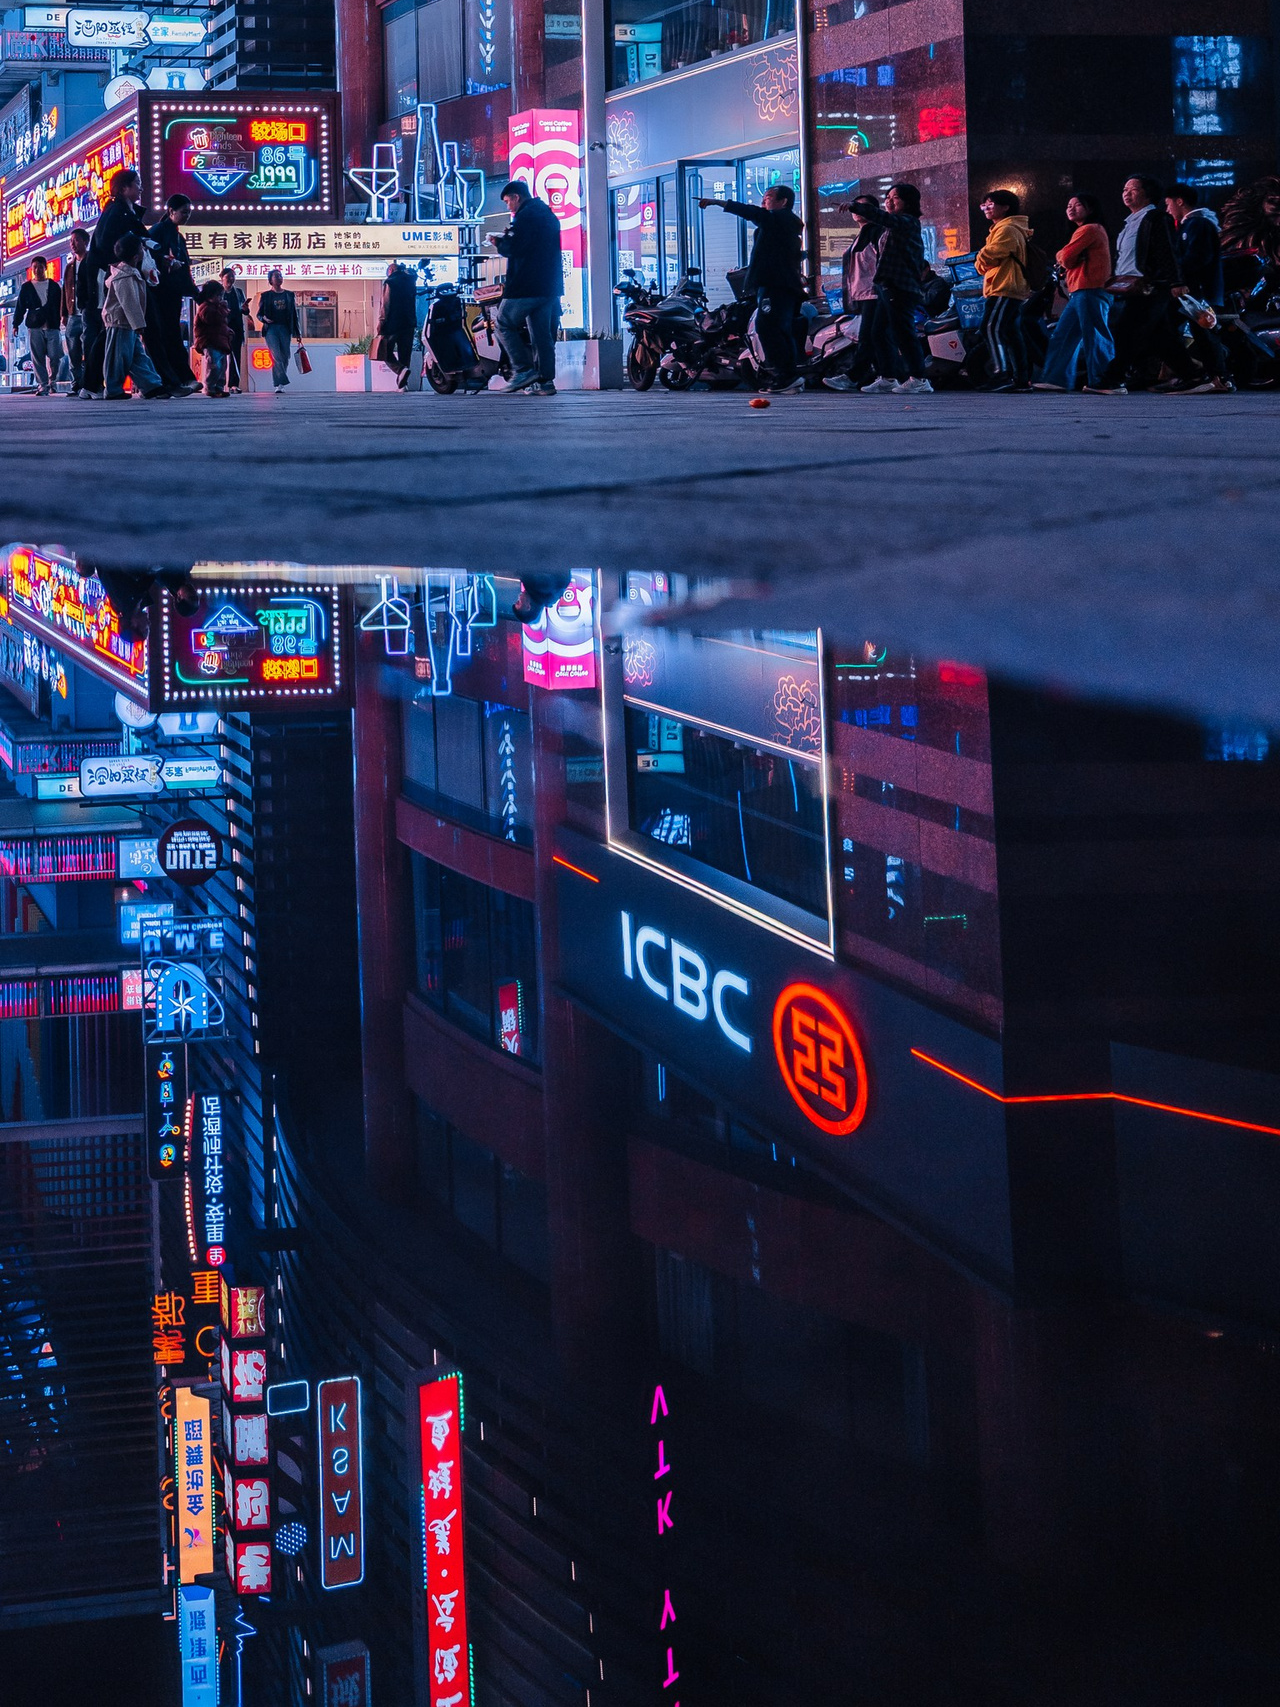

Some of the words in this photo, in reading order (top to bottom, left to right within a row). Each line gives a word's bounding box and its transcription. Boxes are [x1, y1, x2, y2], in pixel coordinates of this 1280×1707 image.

[46, 13, 61, 22] DE
[151, 26, 170, 37] 全家
[171, 29, 202, 38] FamilyMart
[251, 121, 306, 142] 较场口
[260, 165, 297, 182] 1999
[401, 231, 454, 242] UME影城
[300, 262, 364, 277] 第二份半价
